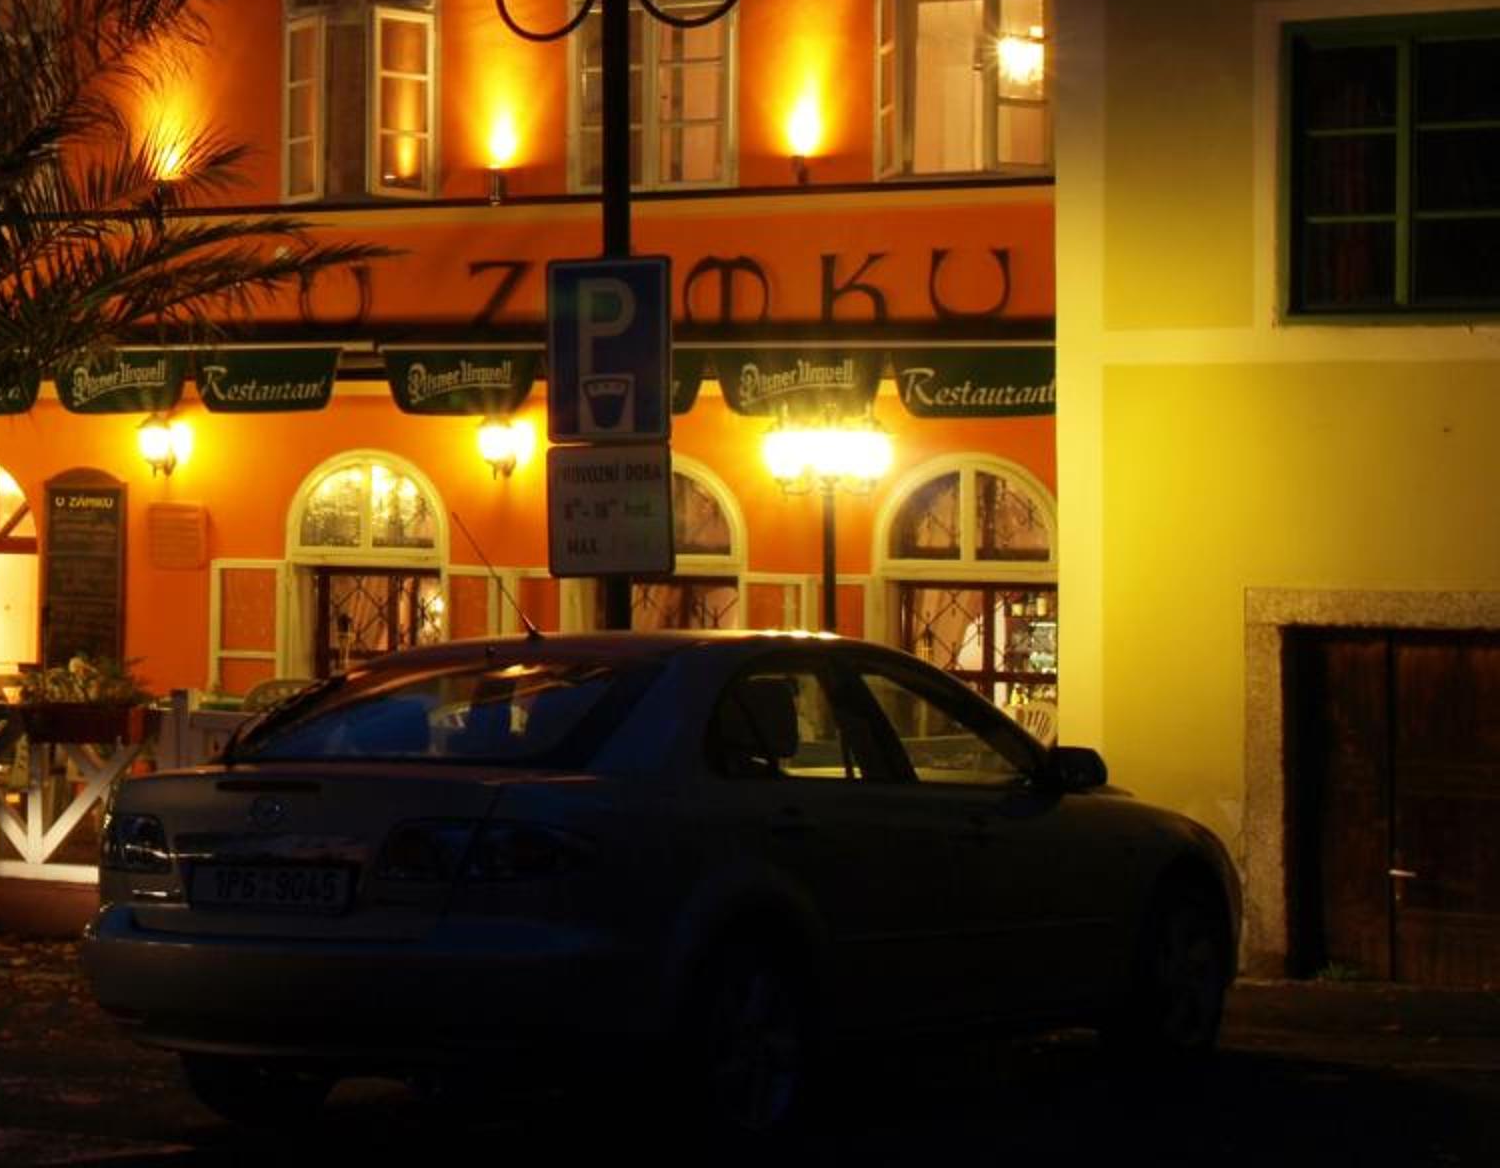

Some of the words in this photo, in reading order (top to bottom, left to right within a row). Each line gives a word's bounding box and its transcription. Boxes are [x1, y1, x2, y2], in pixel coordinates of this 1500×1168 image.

[468, 247, 1012, 325] ZMKU
[578, 277, 637, 375] P
[120, 358, 166, 383] Urquell
[202, 365, 324, 401] Restaurant
[460, 359, 512, 383] Urquell
[797, 358, 853, 384] Urquell
